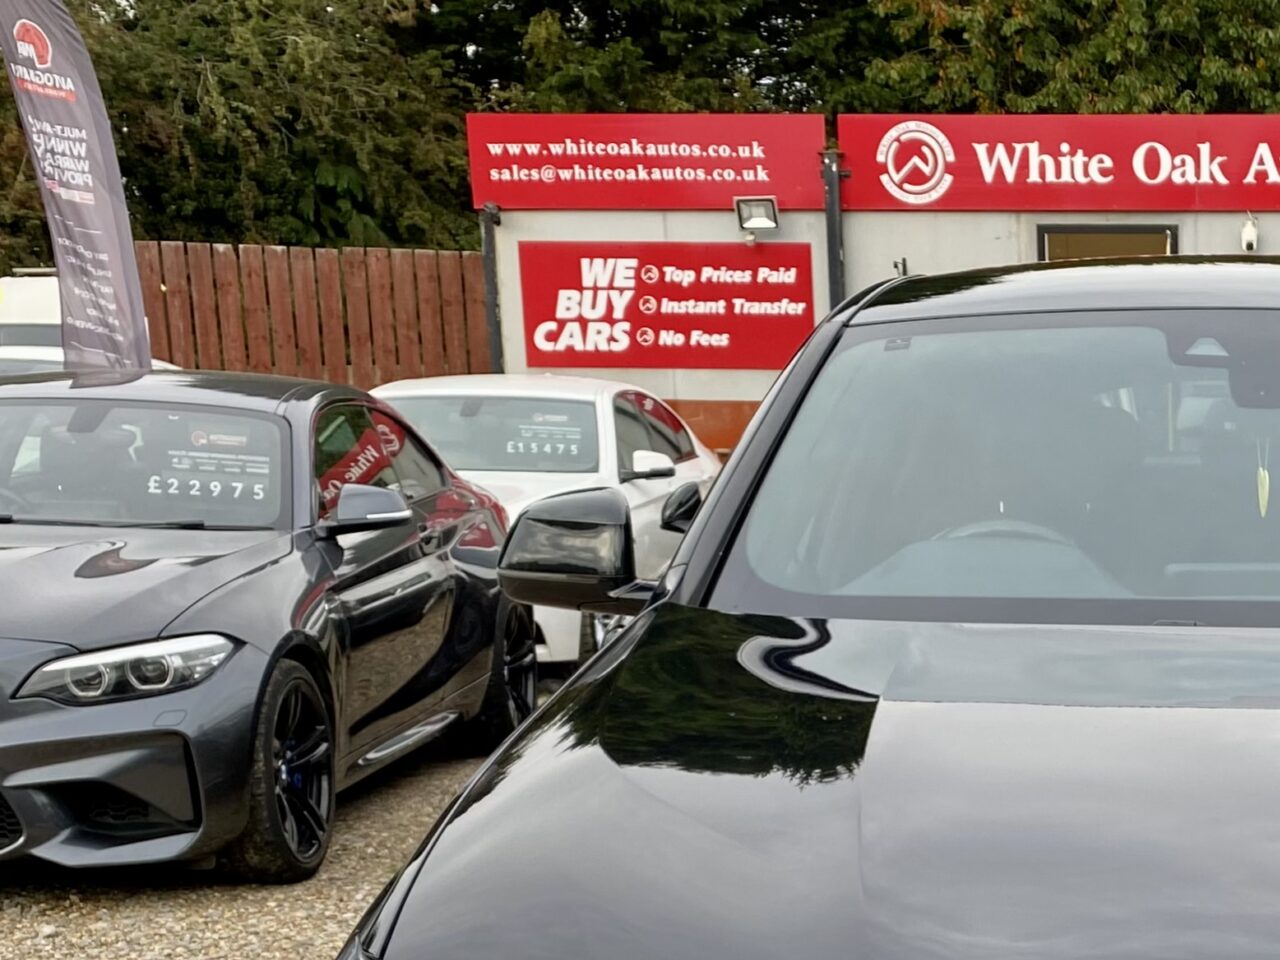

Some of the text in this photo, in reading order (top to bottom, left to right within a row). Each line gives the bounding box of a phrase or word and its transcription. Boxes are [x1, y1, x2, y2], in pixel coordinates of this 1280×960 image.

[486, 138, 765, 158] www.whiteoakautos.co.uk
[489, 164, 769, 183] sales@whiteoakautos.co.uk
[972, 142, 1114, 185] White
[1131, 142, 1229, 185] Oak
[580, 257, 638, 288] WE
[663, 266, 797, 284] Top Prices Paid
[555, 289, 635, 320] BUY
[660, 298, 806, 316] Instant Transfer
[533, 321, 630, 352] CARS
[658, 330, 730, 347] No Fees
[147, 475, 265, 500] £22975
